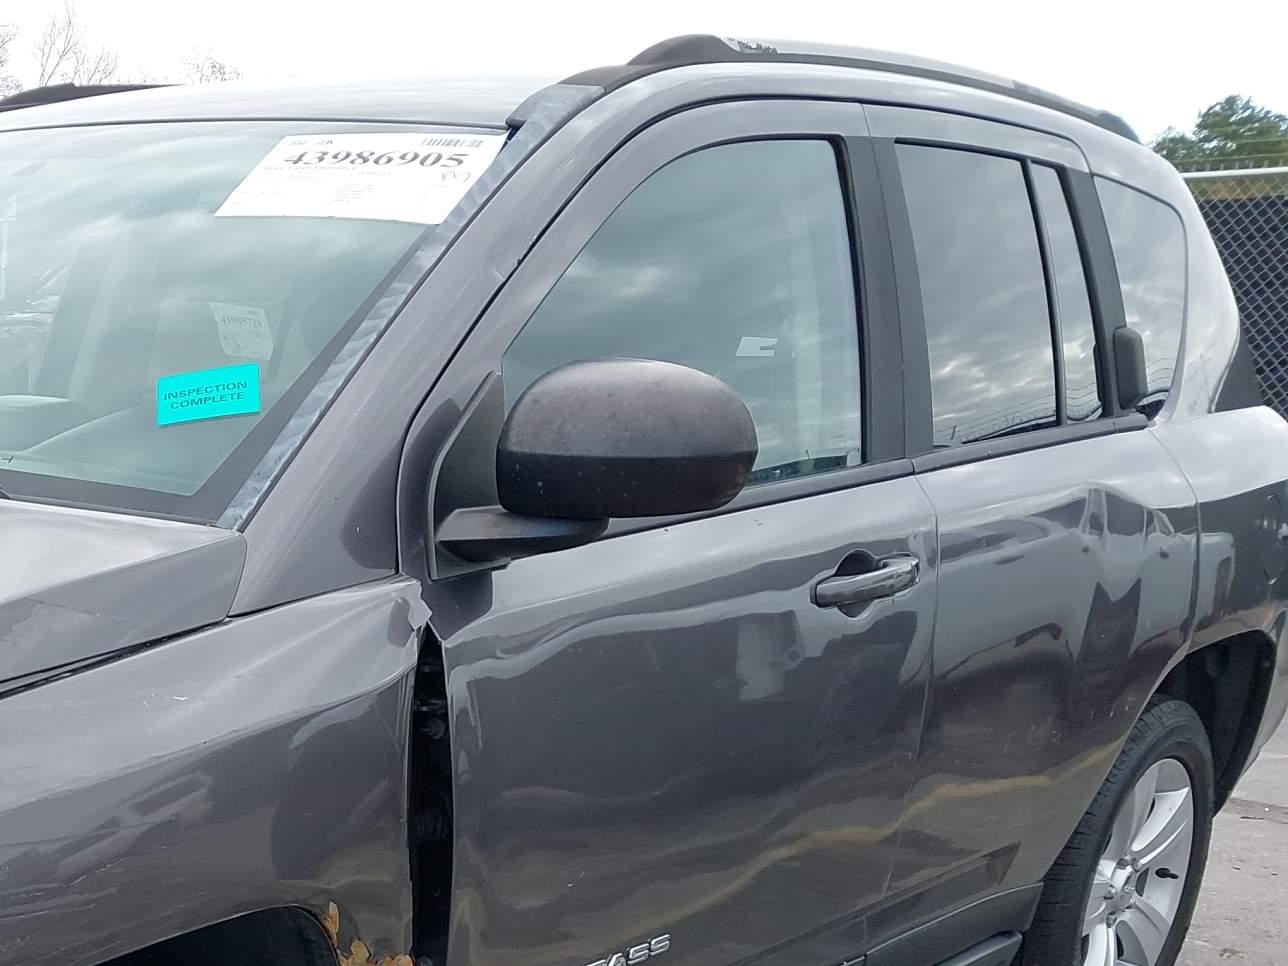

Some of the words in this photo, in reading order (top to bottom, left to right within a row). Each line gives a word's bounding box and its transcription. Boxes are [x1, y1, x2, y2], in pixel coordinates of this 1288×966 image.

[283, 149, 470, 168] 43986905
[163, 379, 249, 401] INSPECTION
[169, 391, 246, 410] COMPLETE
